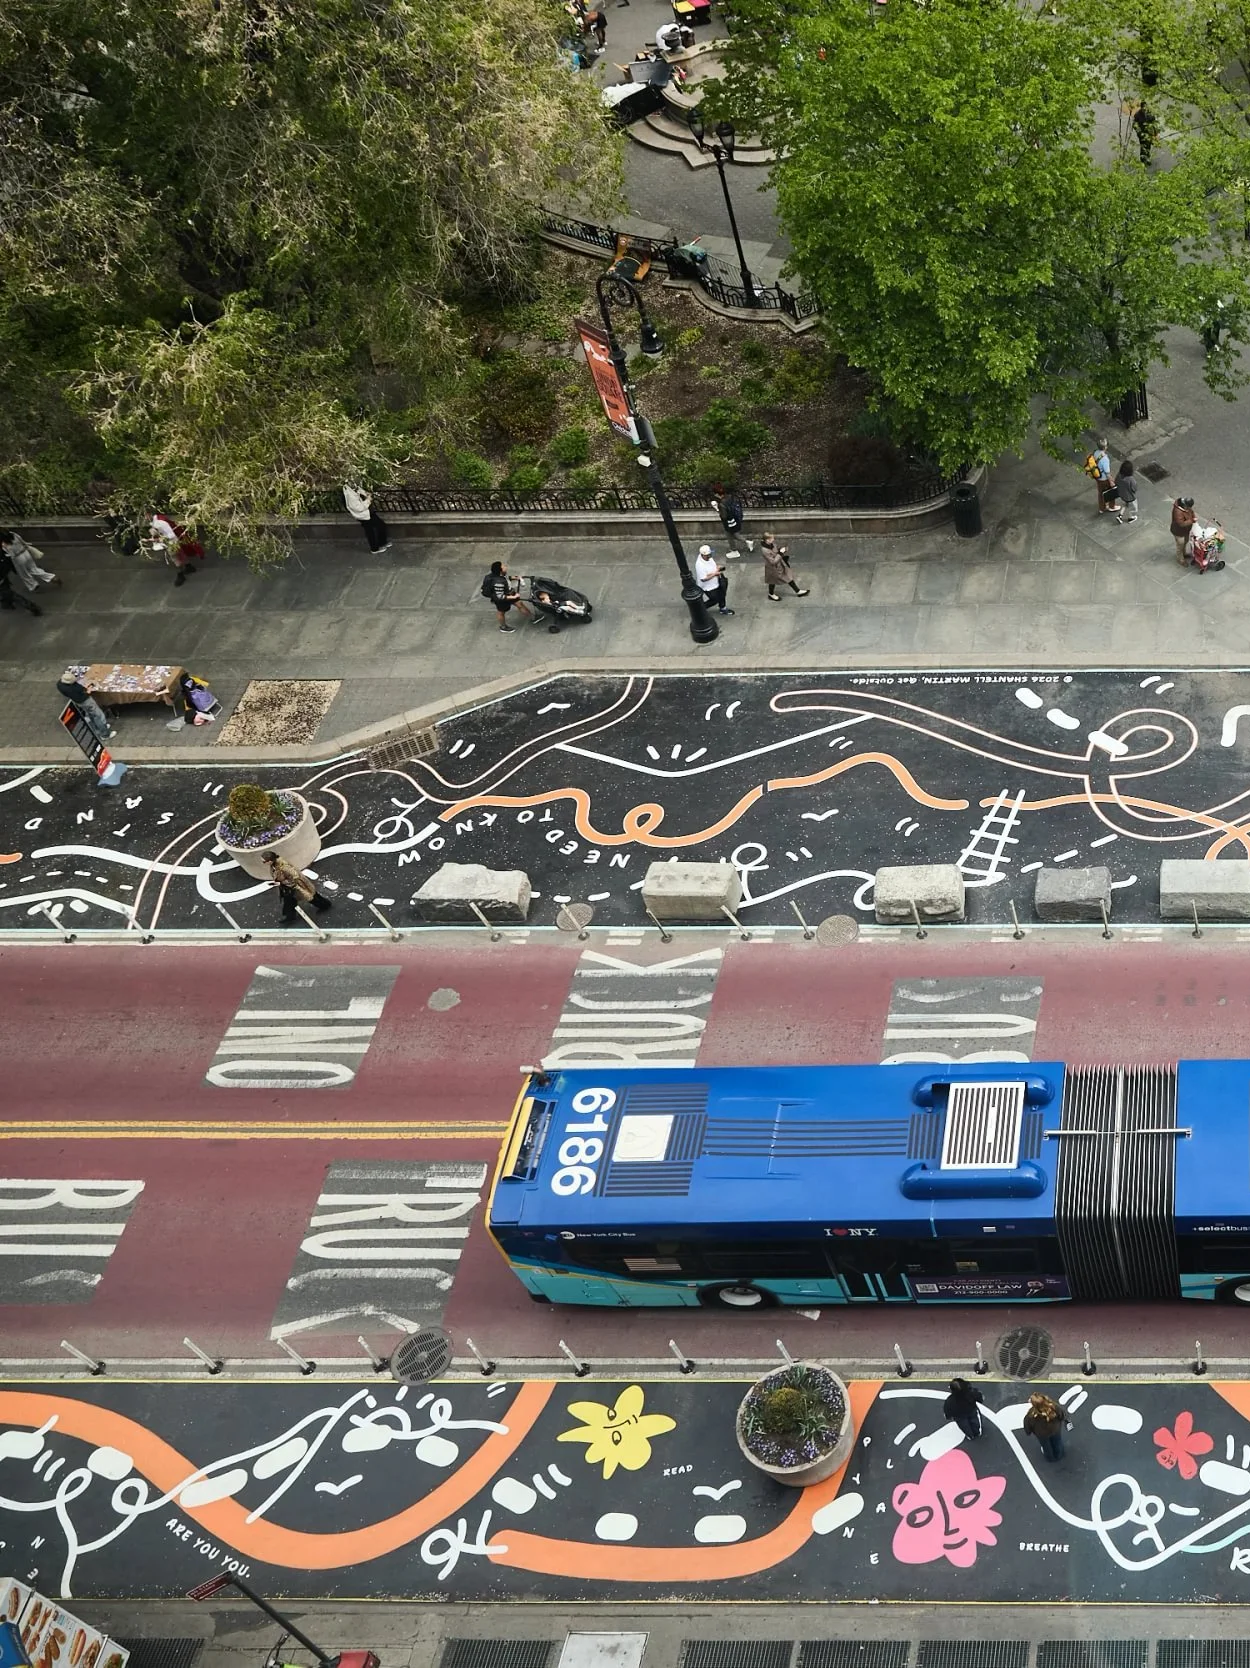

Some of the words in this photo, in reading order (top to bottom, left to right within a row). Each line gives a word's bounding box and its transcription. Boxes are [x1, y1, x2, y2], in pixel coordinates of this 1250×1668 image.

[921, 675, 971, 684] MARTIN,
[974, 675, 1028, 683] SHANTELL
[1031, 675, 1060, 683] 2026
[516, 808, 555, 824] TO
[397, 812, 498, 867] KNOW
[545, 829, 631, 868] NEED
[540, 947, 723, 1069] RUCK
[551, 1087, 617, 1196] 6186
[847, 1228, 877, 1237] NY
[270, 1163, 488, 1341] TRUCK
[663, 1464, 693, 1477] READ
[165, 1518, 193, 1542] ARE
[192, 1537, 220, 1560] YOU
[220, 1555, 250, 1578] YOU.
[1019, 1542, 1070, 1553] BREATHE
